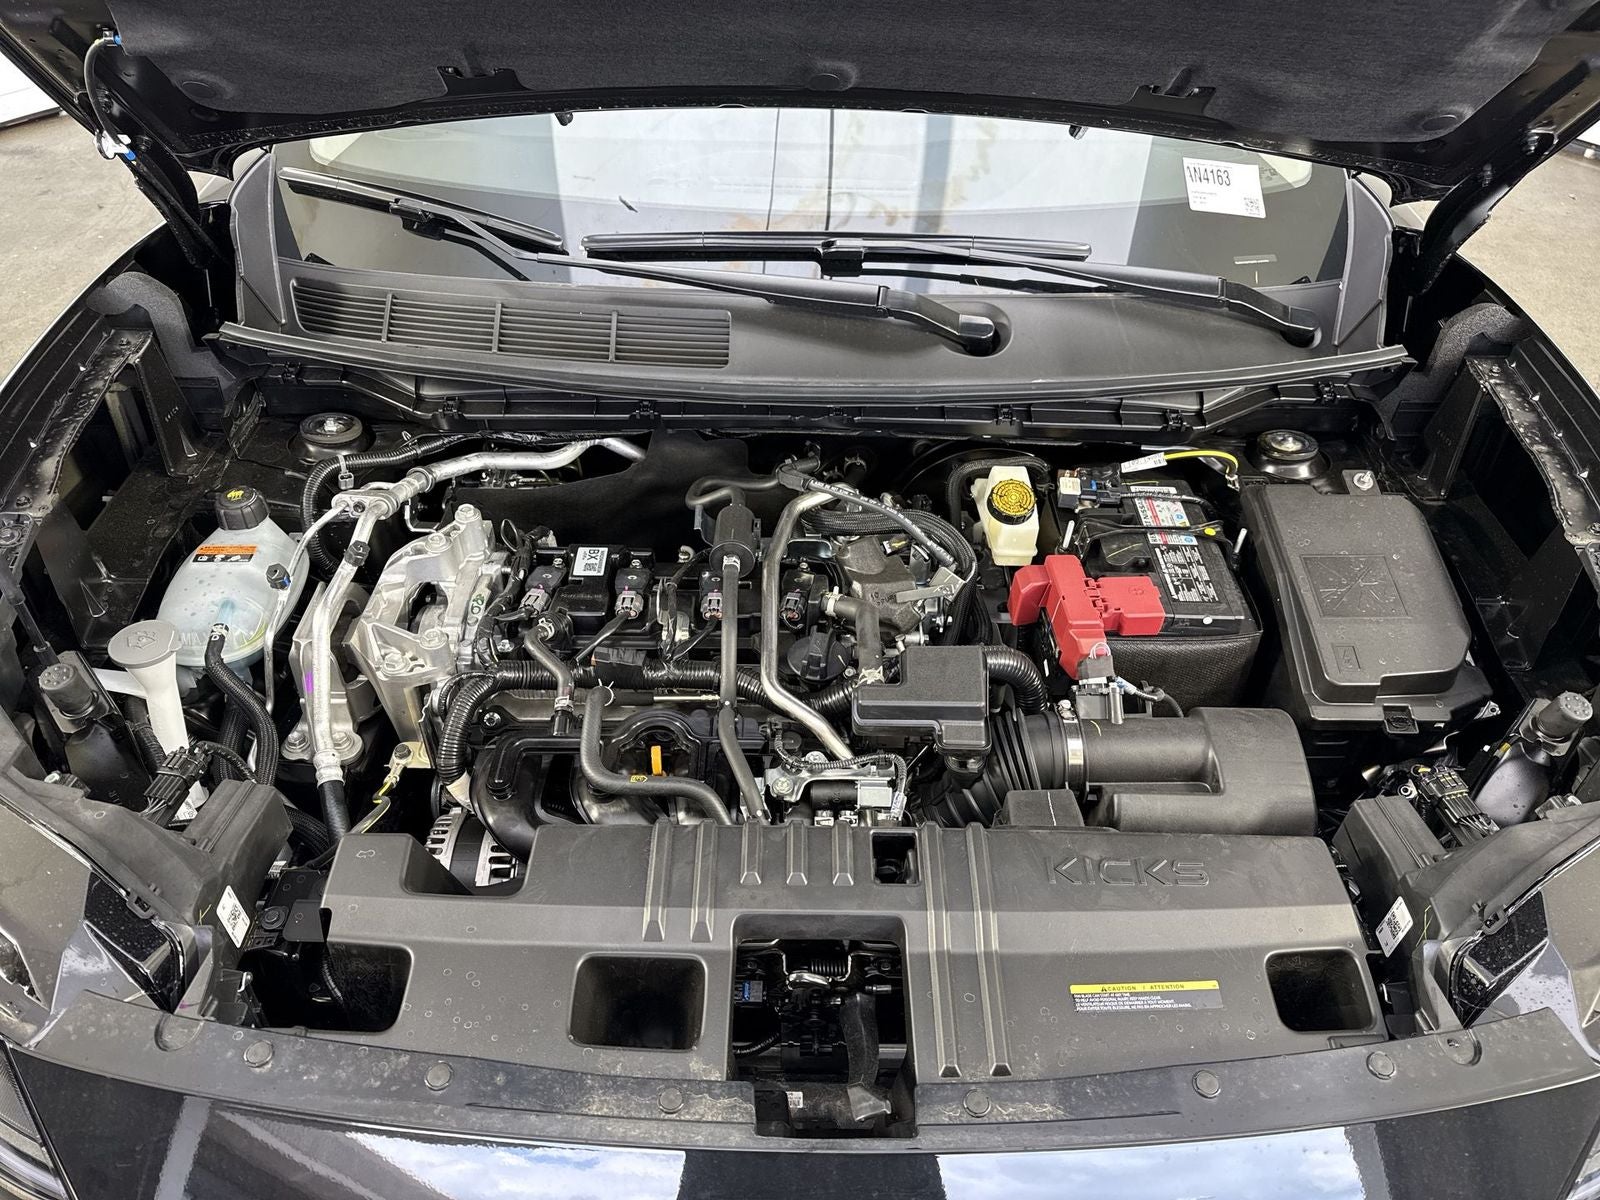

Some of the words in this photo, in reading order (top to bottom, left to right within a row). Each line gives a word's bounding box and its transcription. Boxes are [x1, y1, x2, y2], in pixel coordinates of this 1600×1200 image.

[587, 549, 600, 561] BX
[1045, 856, 1210, 887] KICKS
[1150, 983, 1185, 991] ATTENTION
